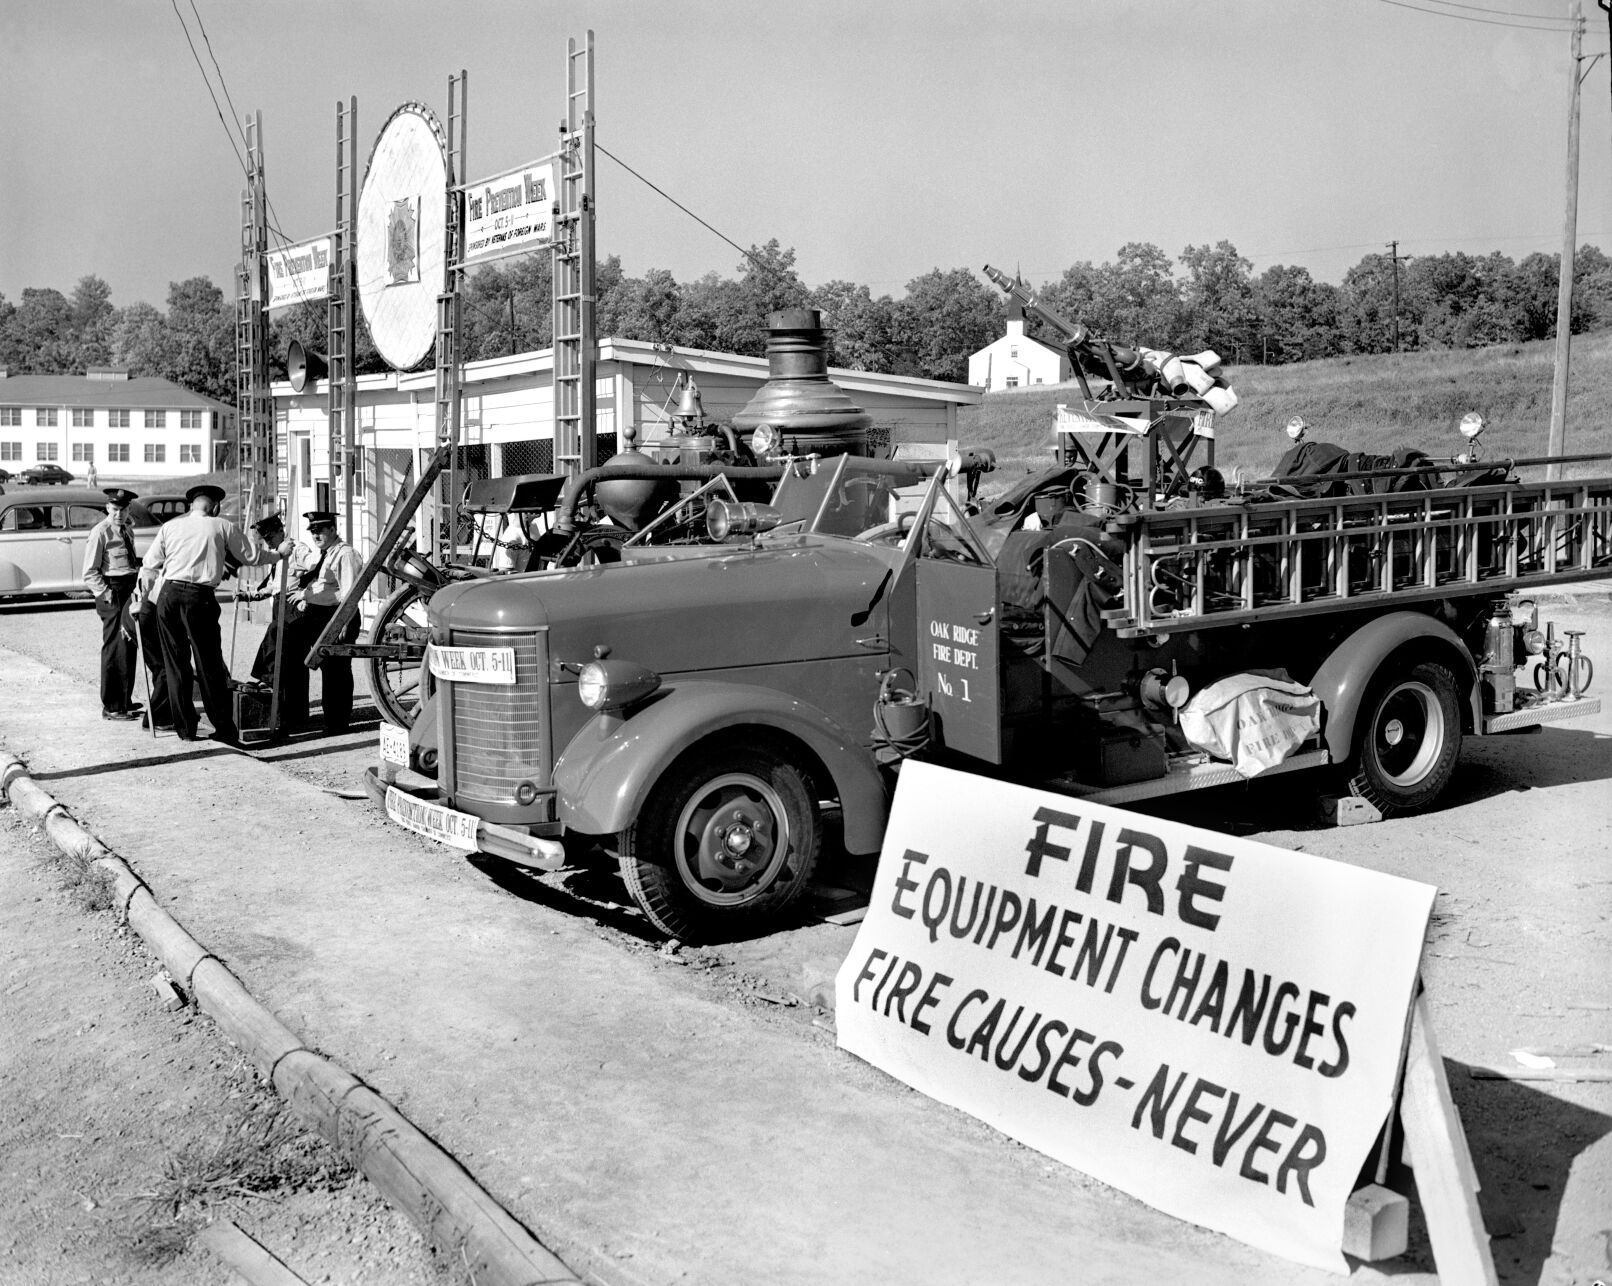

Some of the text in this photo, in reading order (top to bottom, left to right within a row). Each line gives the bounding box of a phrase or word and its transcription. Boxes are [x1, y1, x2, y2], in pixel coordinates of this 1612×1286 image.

[523, 173, 547, 204] WEEK
[533, 222, 547, 233] WARS
[930, 620, 979, 646] OAK RIDGE
[441, 650, 467, 670] WEEK
[470, 651, 489, 671] OCT.
[933, 643, 978, 670] FIRE DEPT.
[960, 678, 972, 702] 1
[426, 808, 444, 831] WEEK
[1025, 806, 1234, 932] FIRE
[891, 848, 1357, 1079] EQUIPMENT CHANGES
[853, 947, 954, 1036] FIRE
